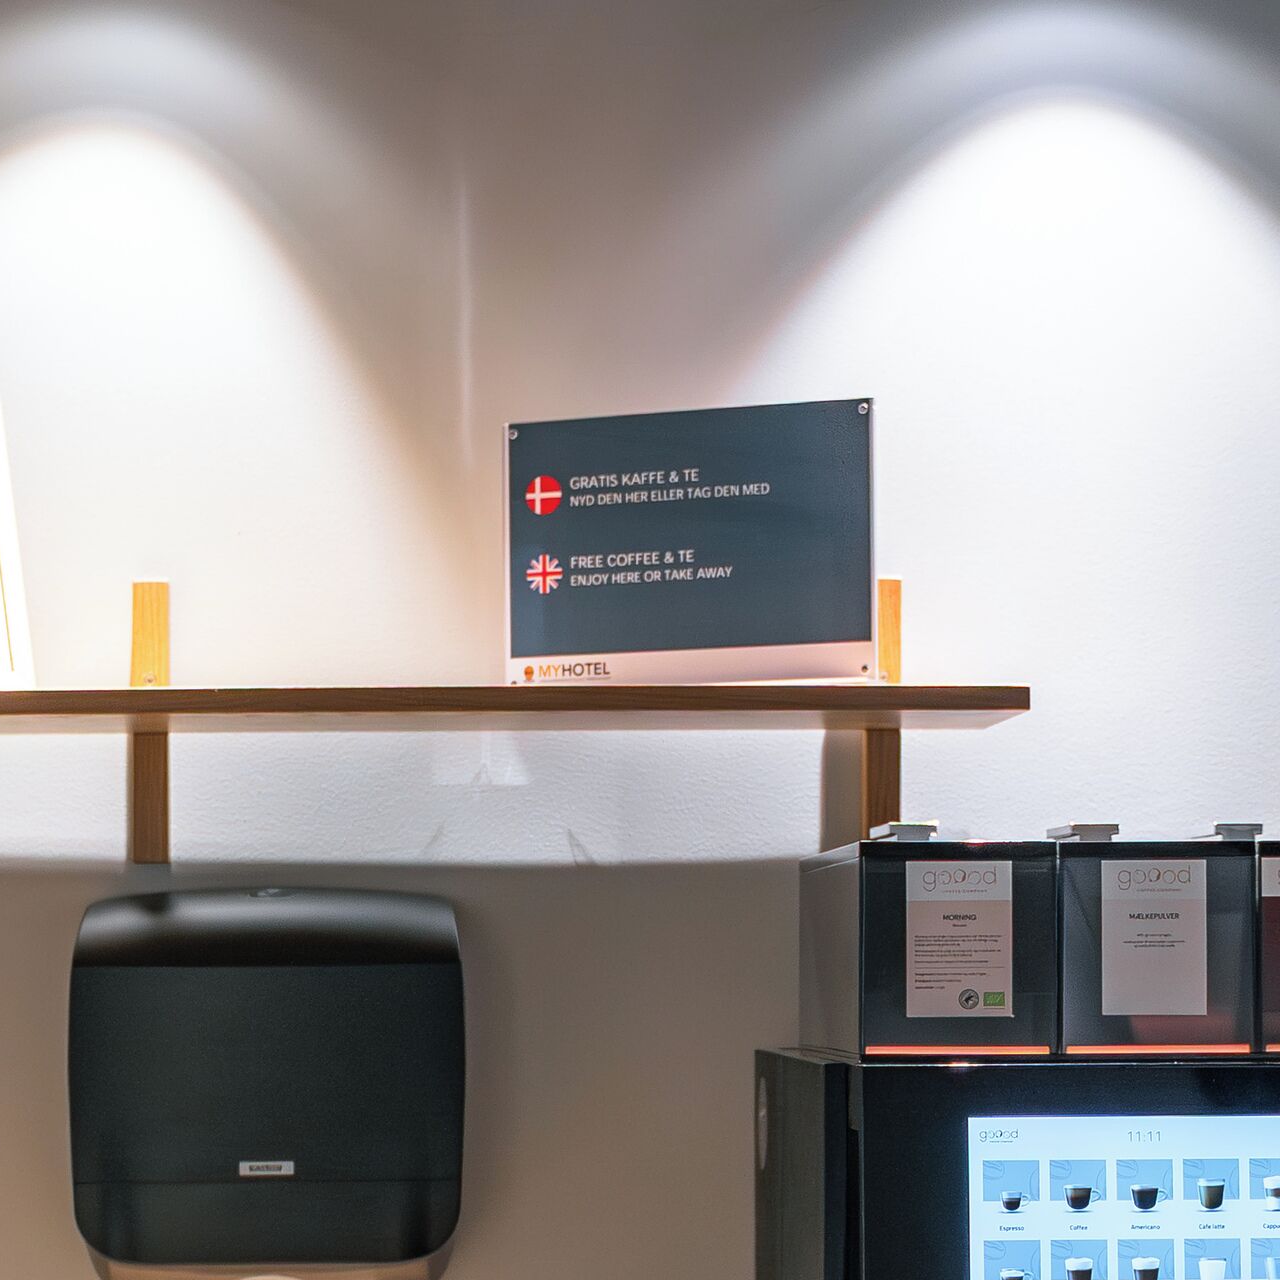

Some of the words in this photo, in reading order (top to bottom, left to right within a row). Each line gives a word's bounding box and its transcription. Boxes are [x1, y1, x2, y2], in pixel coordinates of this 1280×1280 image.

[570, 474, 618, 490] GRATIS
[622, 471, 665, 486] KAFFE
[669, 470, 679, 484] &
[683, 469, 699, 482] TE
[570, 494, 595, 507] NYD
[597, 492, 622, 506] DEN
[625, 490, 648, 504] HER
[651, 487, 684, 502] ELLER
[687, 486, 711, 499] TAG
[715, 484, 739, 498] DEN
[742, 482, 770, 496] MED
[570, 555, 603, 569] FREE
[607, 551, 660, 567] COFFEE
[664, 551, 674, 564] &
[678, 549, 694, 563] TE
[570, 573, 608, 587] ENJOY
[611, 571, 641, 585] HERE
[643, 570, 661, 583] OR
[665, 568, 694, 582] TAKE
[696, 566, 733, 580] AWAY
[942, 913, 977, 921] MORNING
[1128, 912, 1179, 920] MÆLKEPULVER
[1128, 1130, 1162, 1142] 11:11
